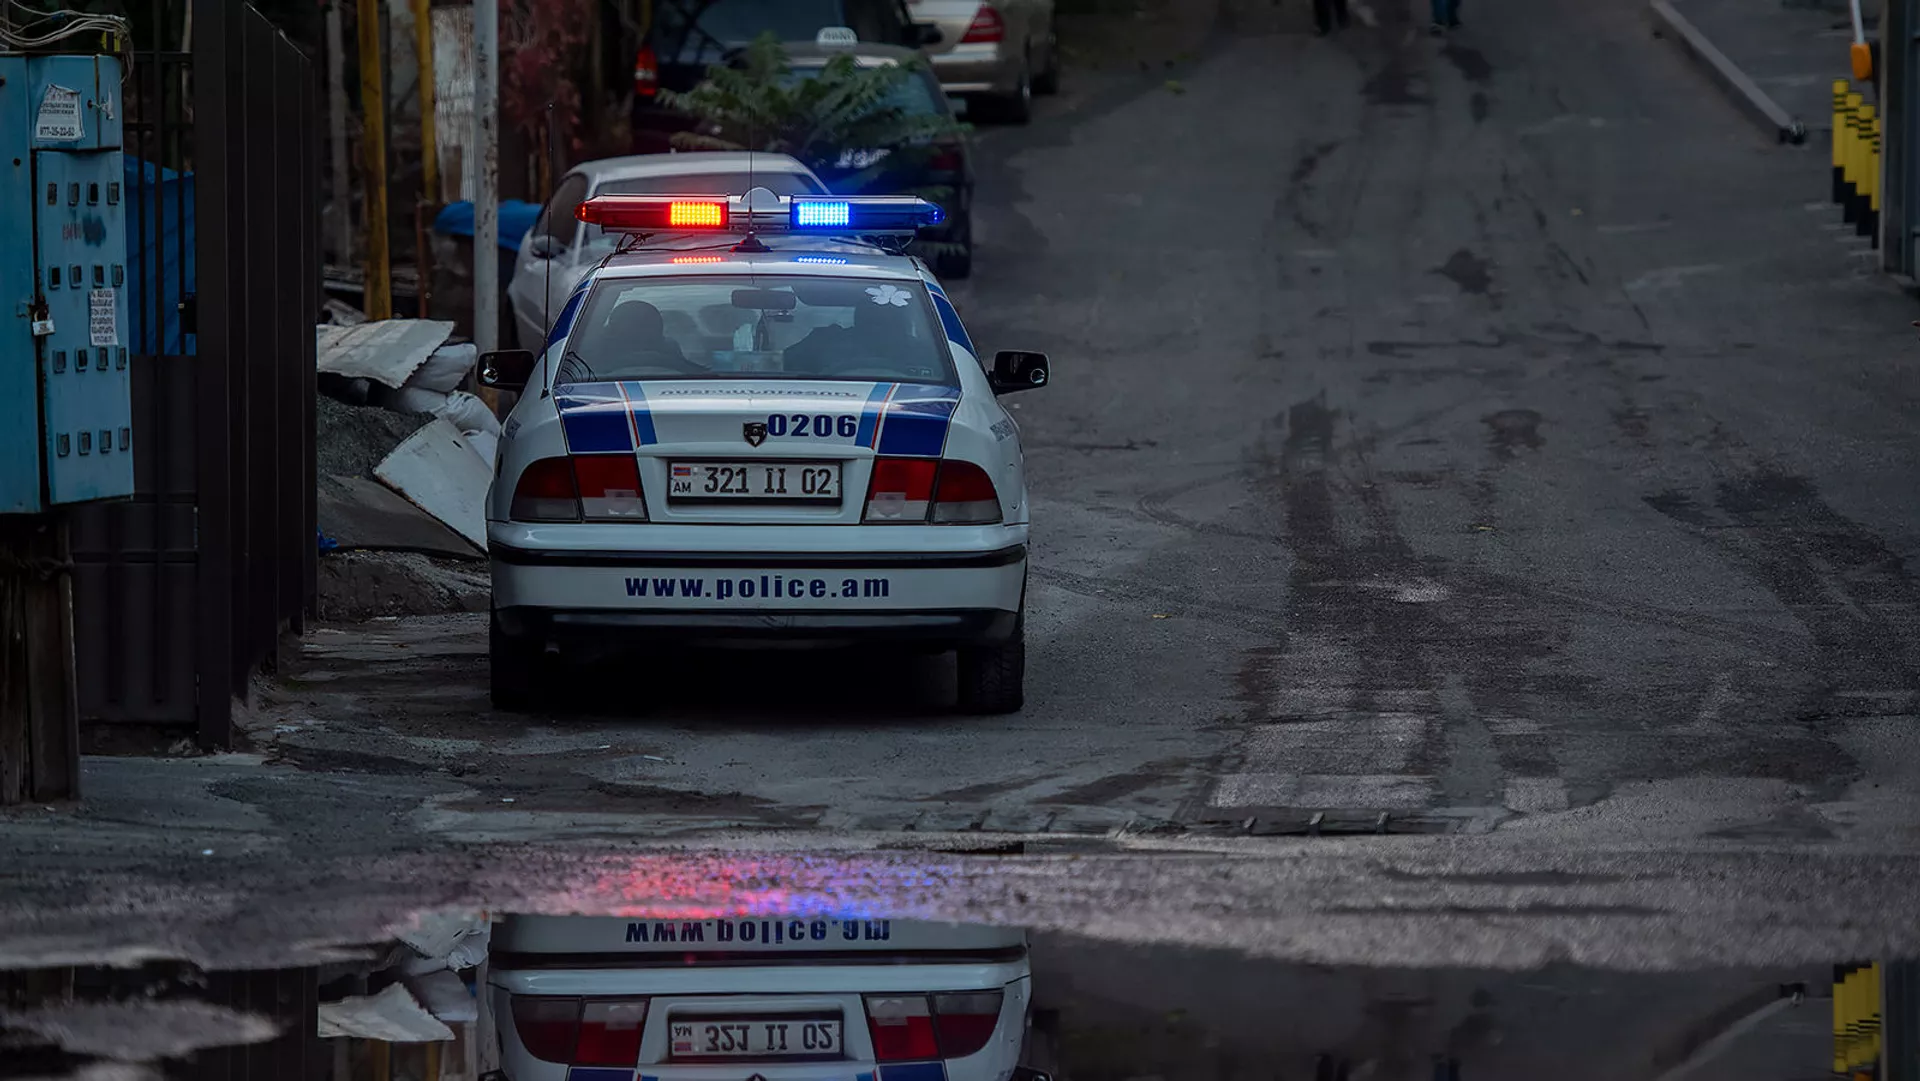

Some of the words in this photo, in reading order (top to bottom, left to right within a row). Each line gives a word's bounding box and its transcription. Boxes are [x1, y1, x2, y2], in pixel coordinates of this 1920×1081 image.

[767, 413, 857, 437] 0206
[673, 481, 692, 493] AM
[704, 466, 750, 494] 321
[801, 467, 832, 495] 02
[625, 575, 890, 600] www.police.am
